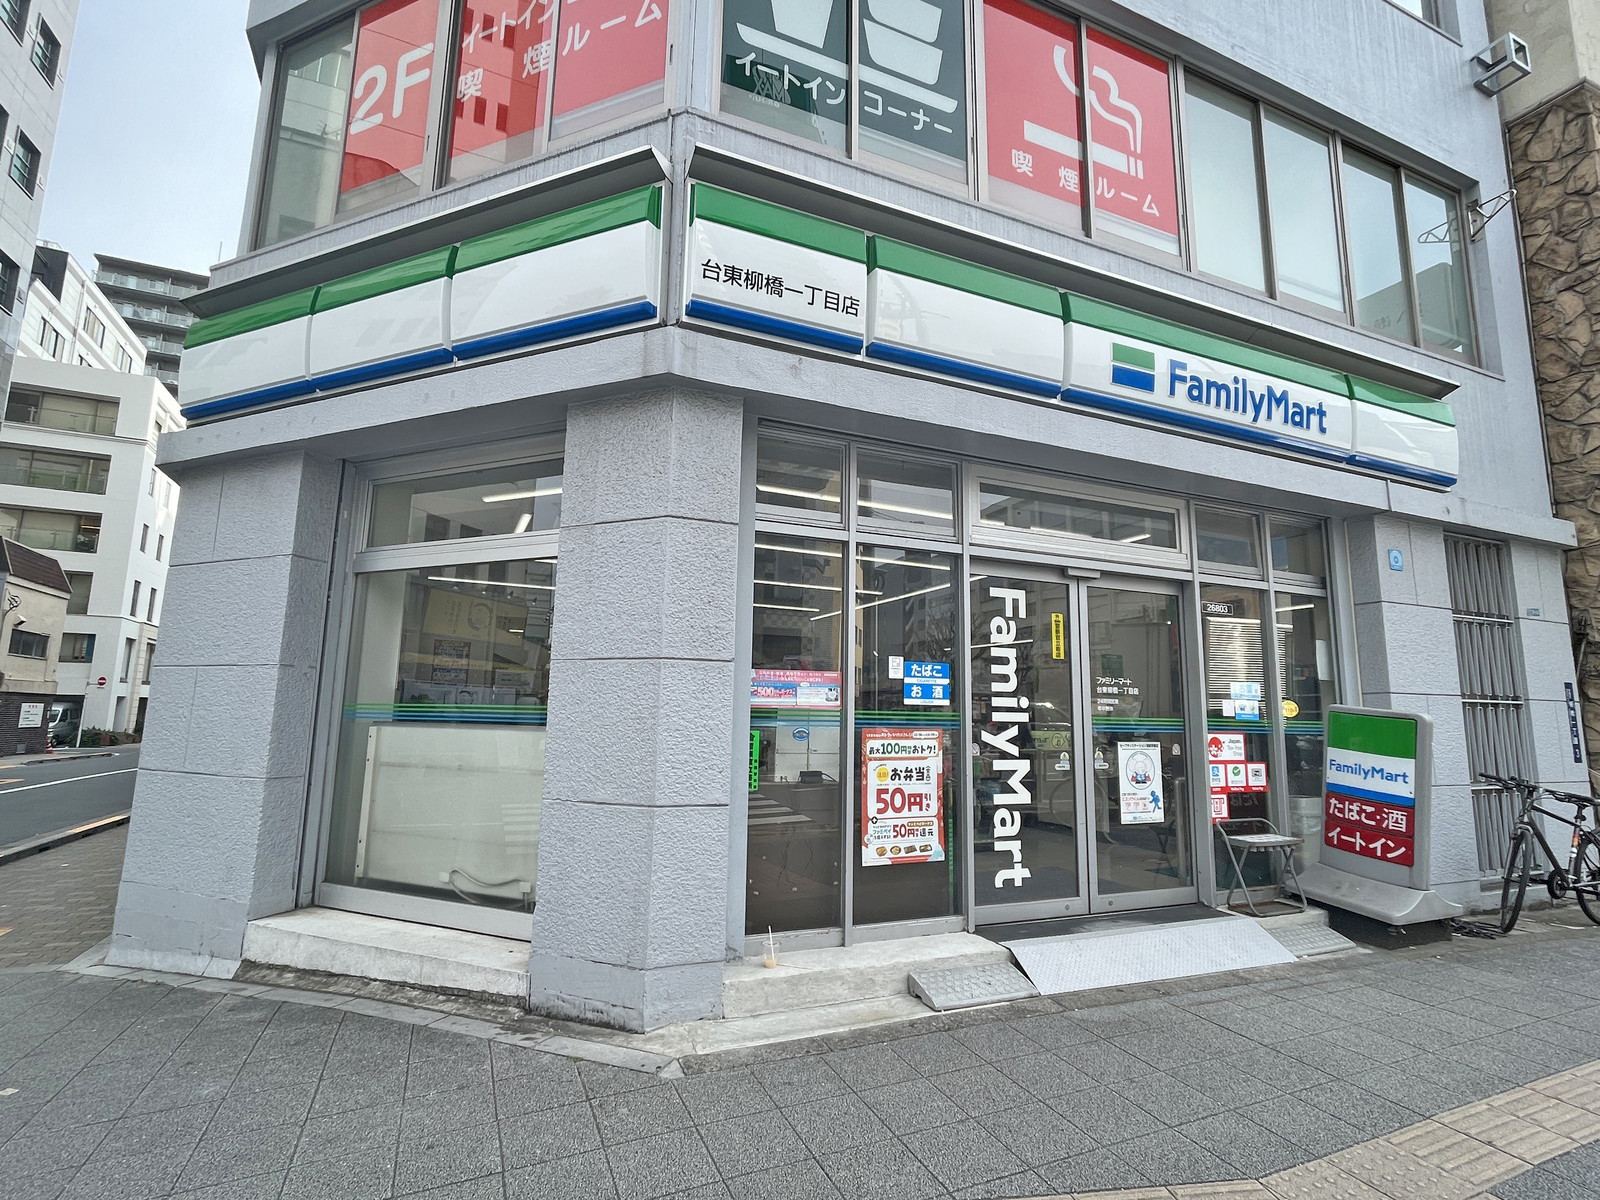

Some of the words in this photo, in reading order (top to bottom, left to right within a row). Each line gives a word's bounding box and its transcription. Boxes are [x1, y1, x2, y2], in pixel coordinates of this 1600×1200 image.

[350, 42, 434, 135] 2F
[701, 258, 860, 317] 台東柳橋一丁目店
[1168, 358, 1327, 434] FamilyMart
[1206, 603, 1229, 613] 26803
[911, 663, 943, 677] たばこ
[1096, 676, 1132, 686] ファミリーマート
[981, 586, 1032, 888] FamilyMart
[890, 766, 925, 781] お弁当
[1329, 758, 1409, 784] FamilyMart
[1327, 827, 1407, 859] イートイン
